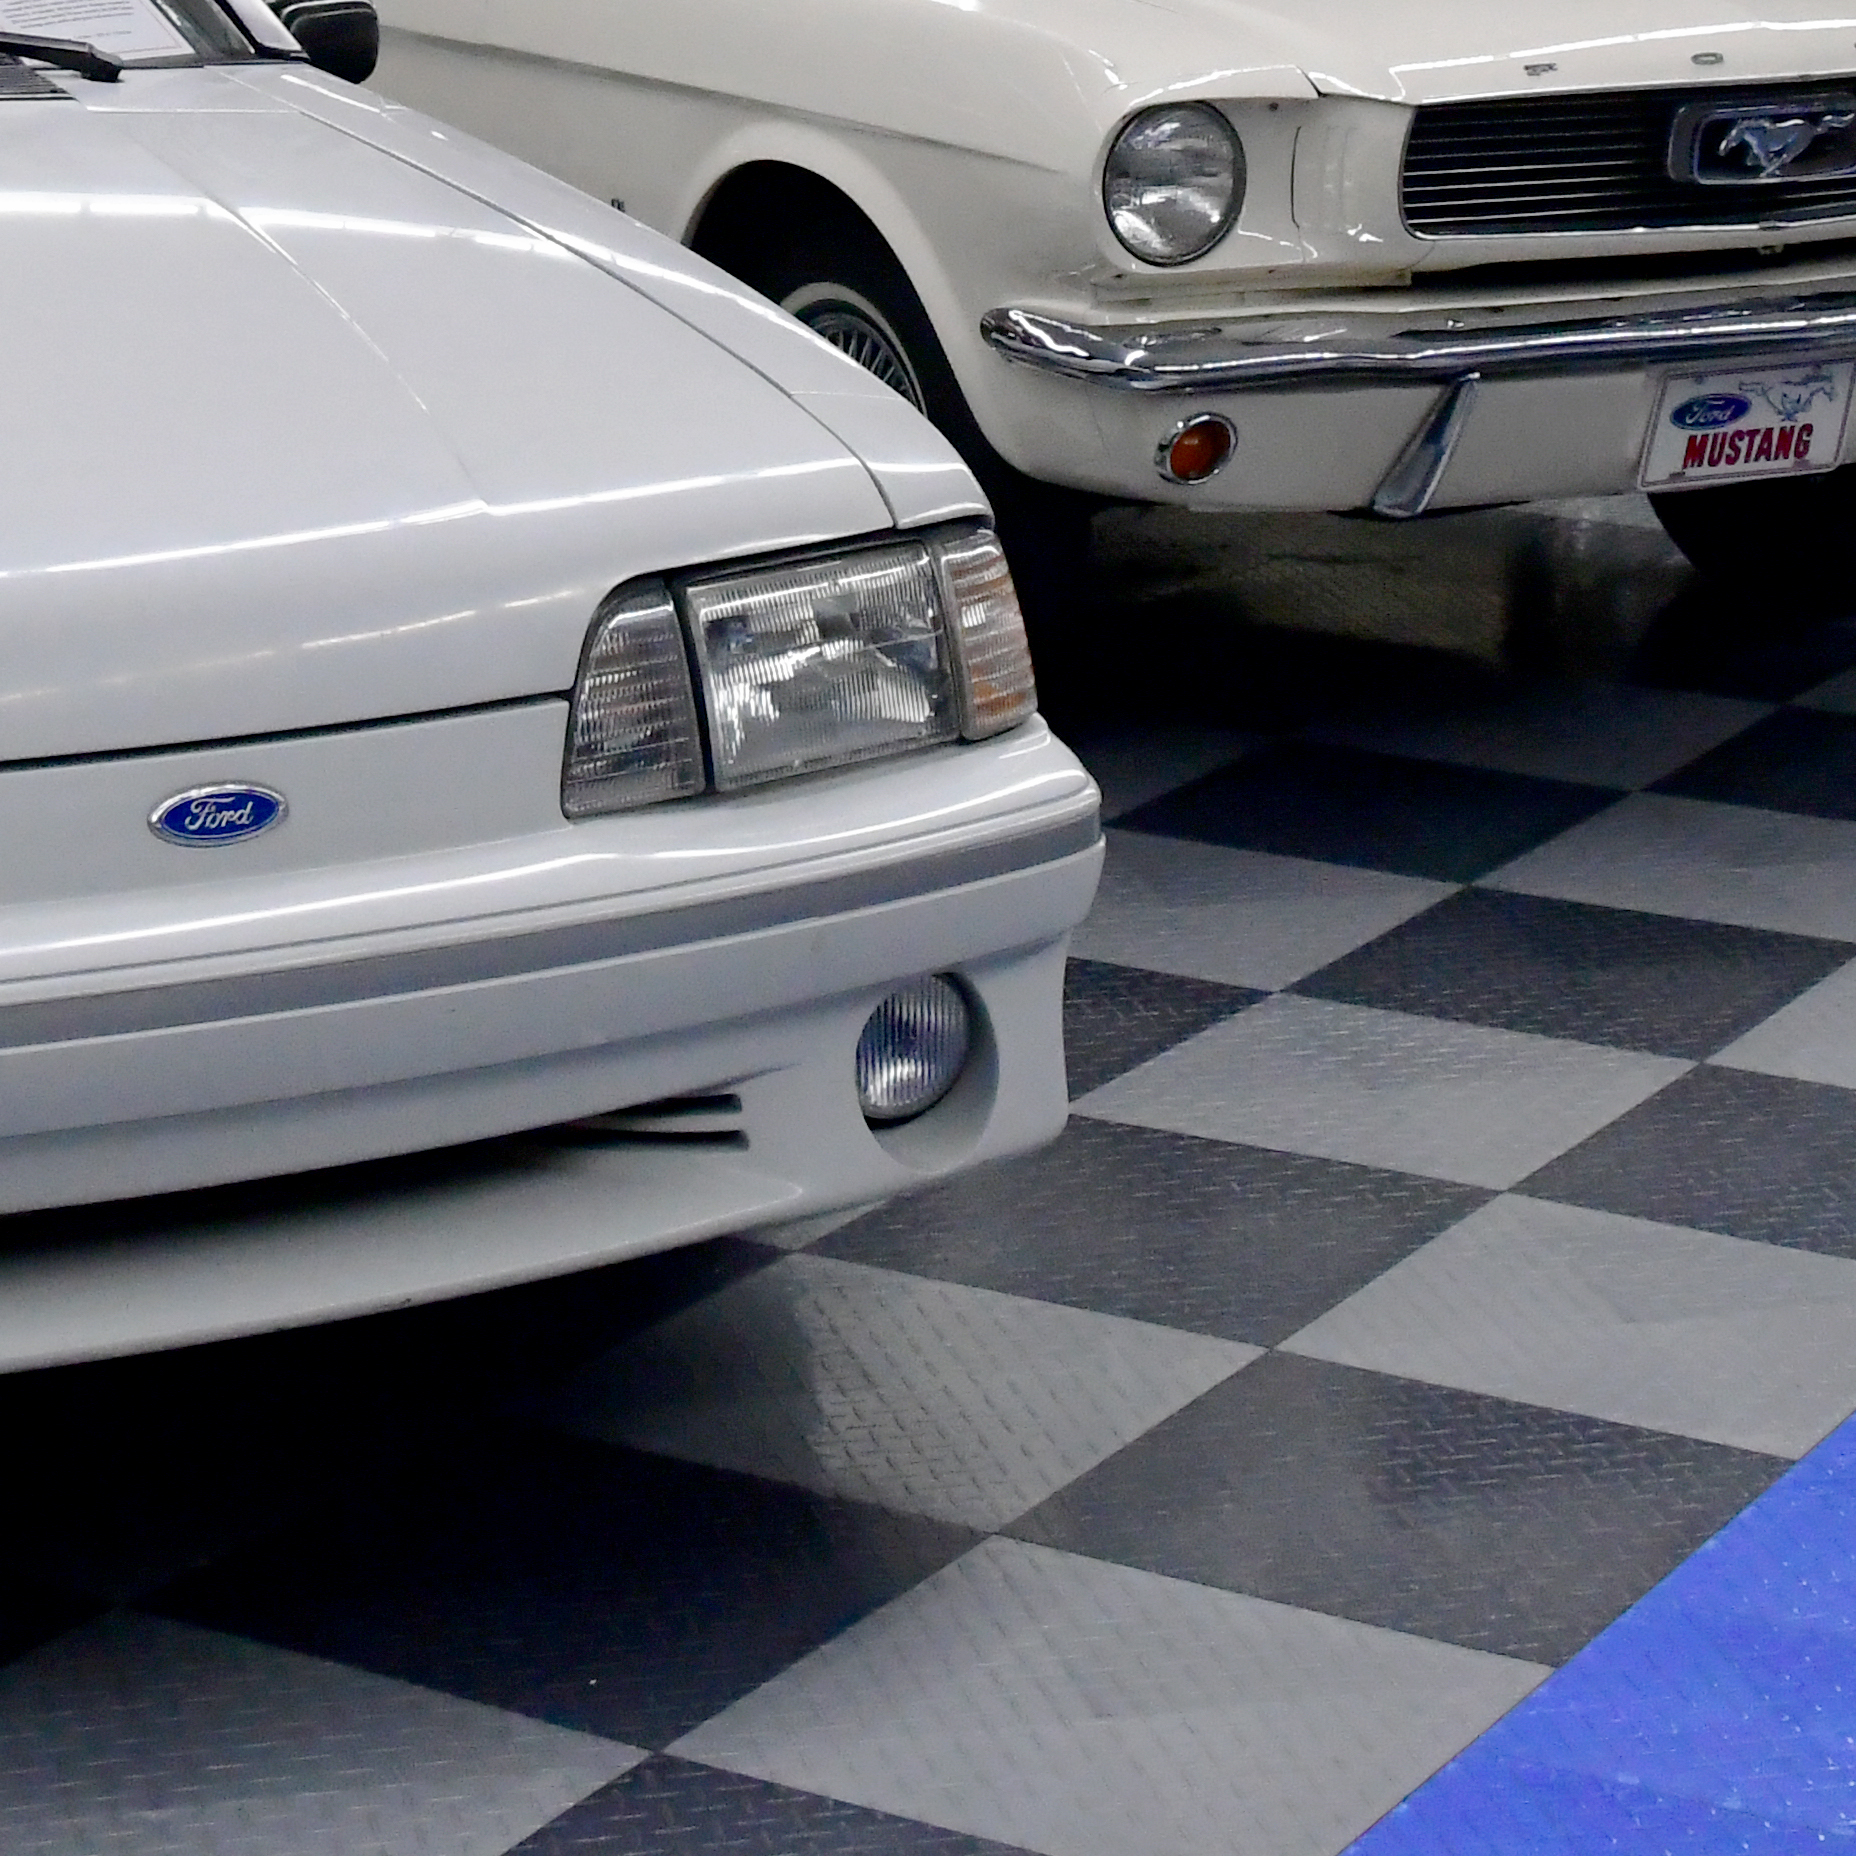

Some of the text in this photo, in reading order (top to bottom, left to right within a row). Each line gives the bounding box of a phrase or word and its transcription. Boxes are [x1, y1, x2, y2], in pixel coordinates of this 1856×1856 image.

[1685, 399, 1737, 425] Ford
[1683, 423, 1814, 470] MUSTANG
[185, 796, 254, 831] Ford
